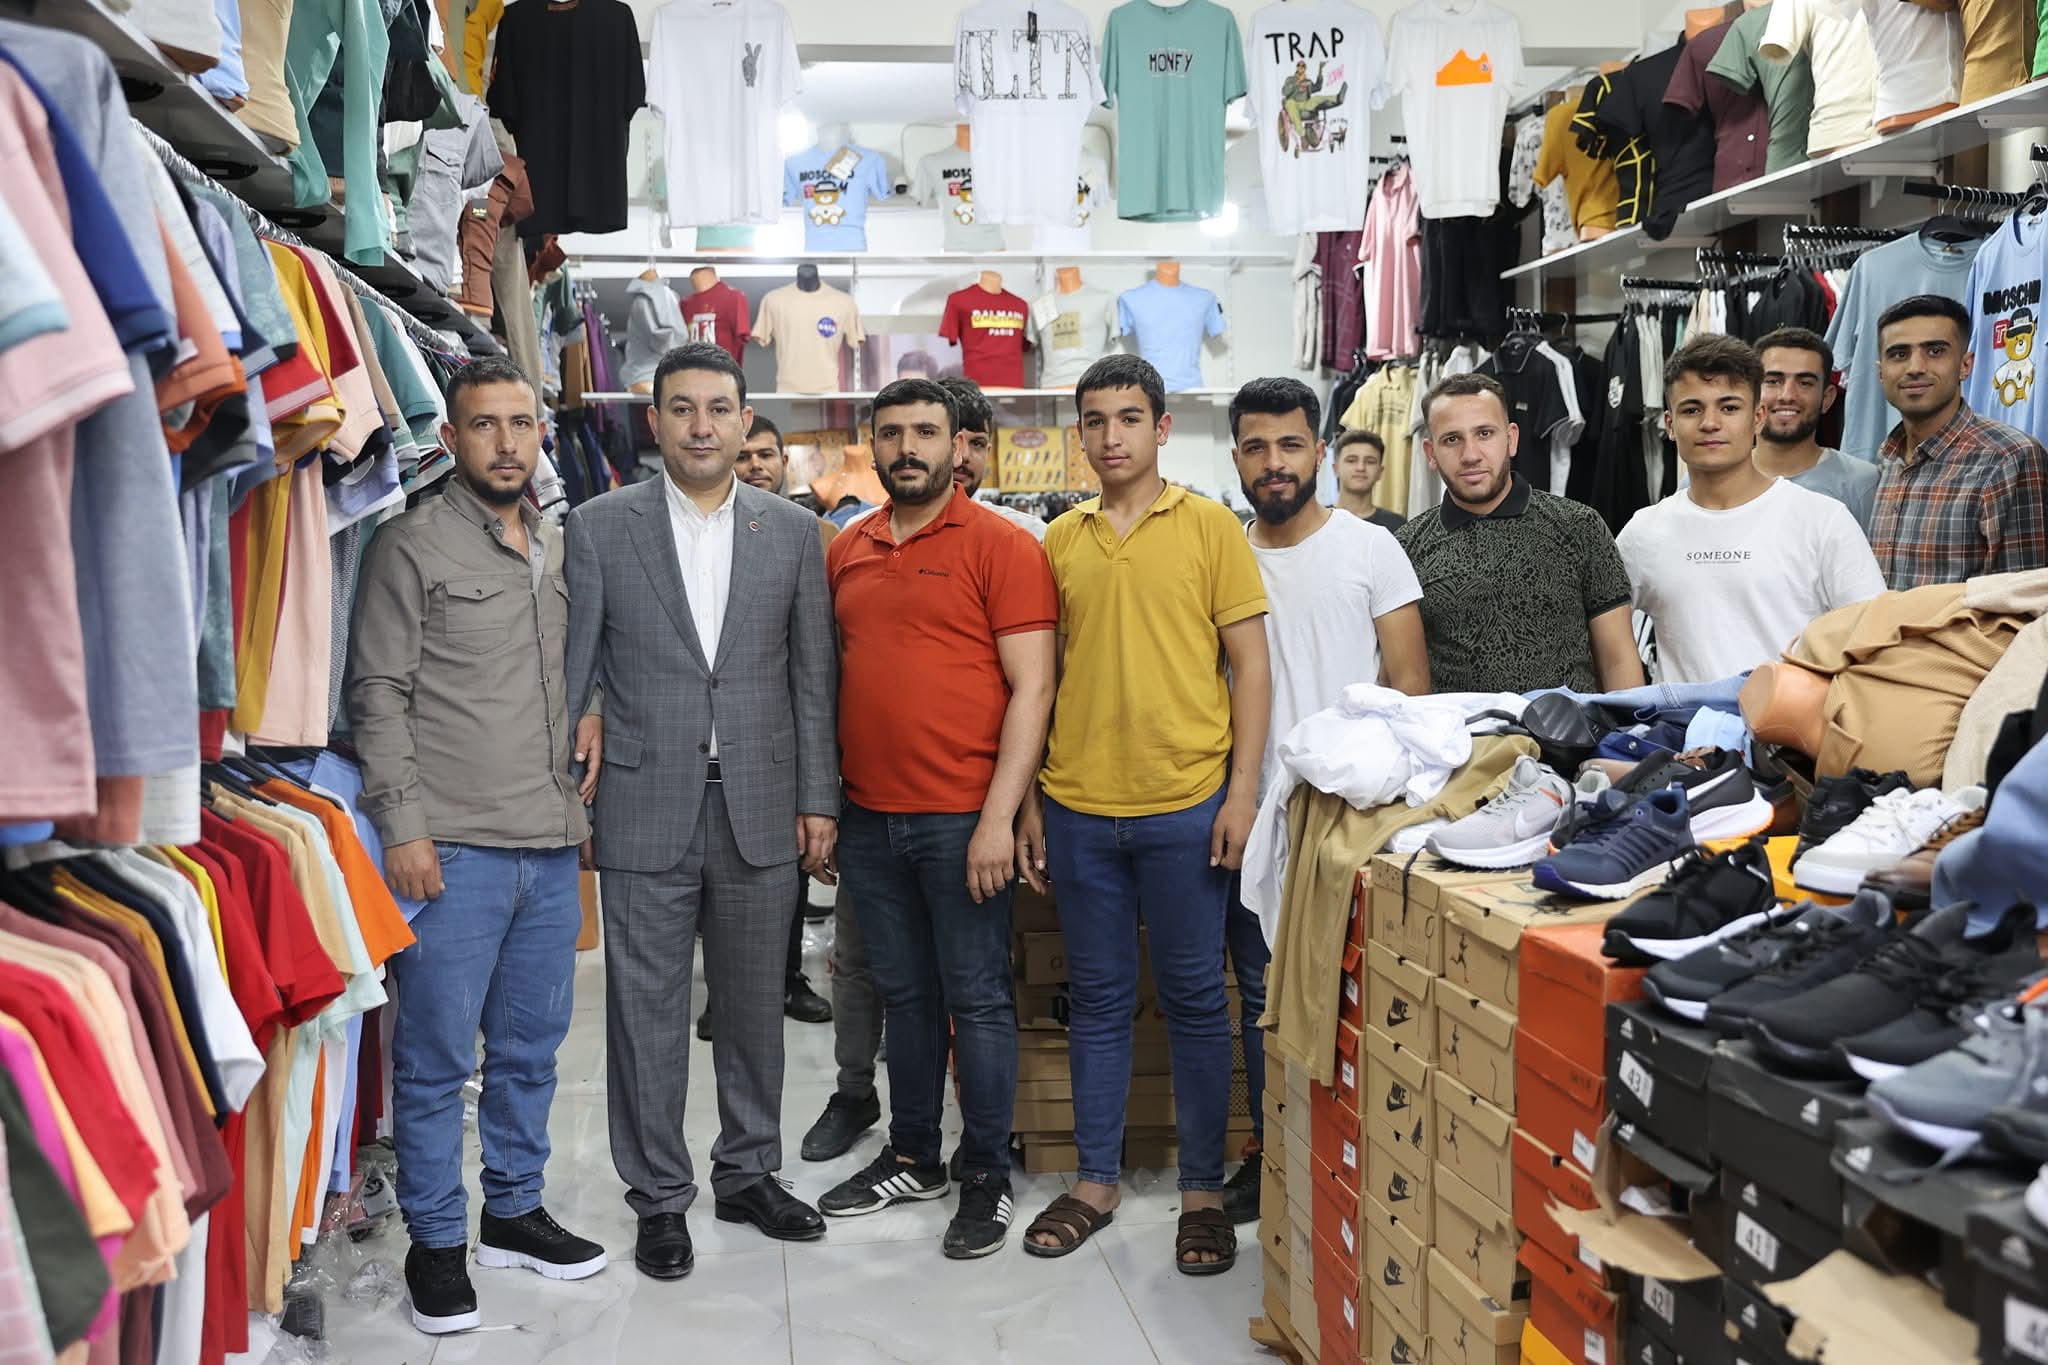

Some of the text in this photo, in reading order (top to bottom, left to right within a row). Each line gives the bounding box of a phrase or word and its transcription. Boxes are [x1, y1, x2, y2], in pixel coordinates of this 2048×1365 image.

[1264, 27, 1344, 64] TRAP
[1686, 551, 1752, 561] SOMEONE
[1627, 1068, 1641, 1092] 43
[1745, 1228, 1761, 1256] 41
